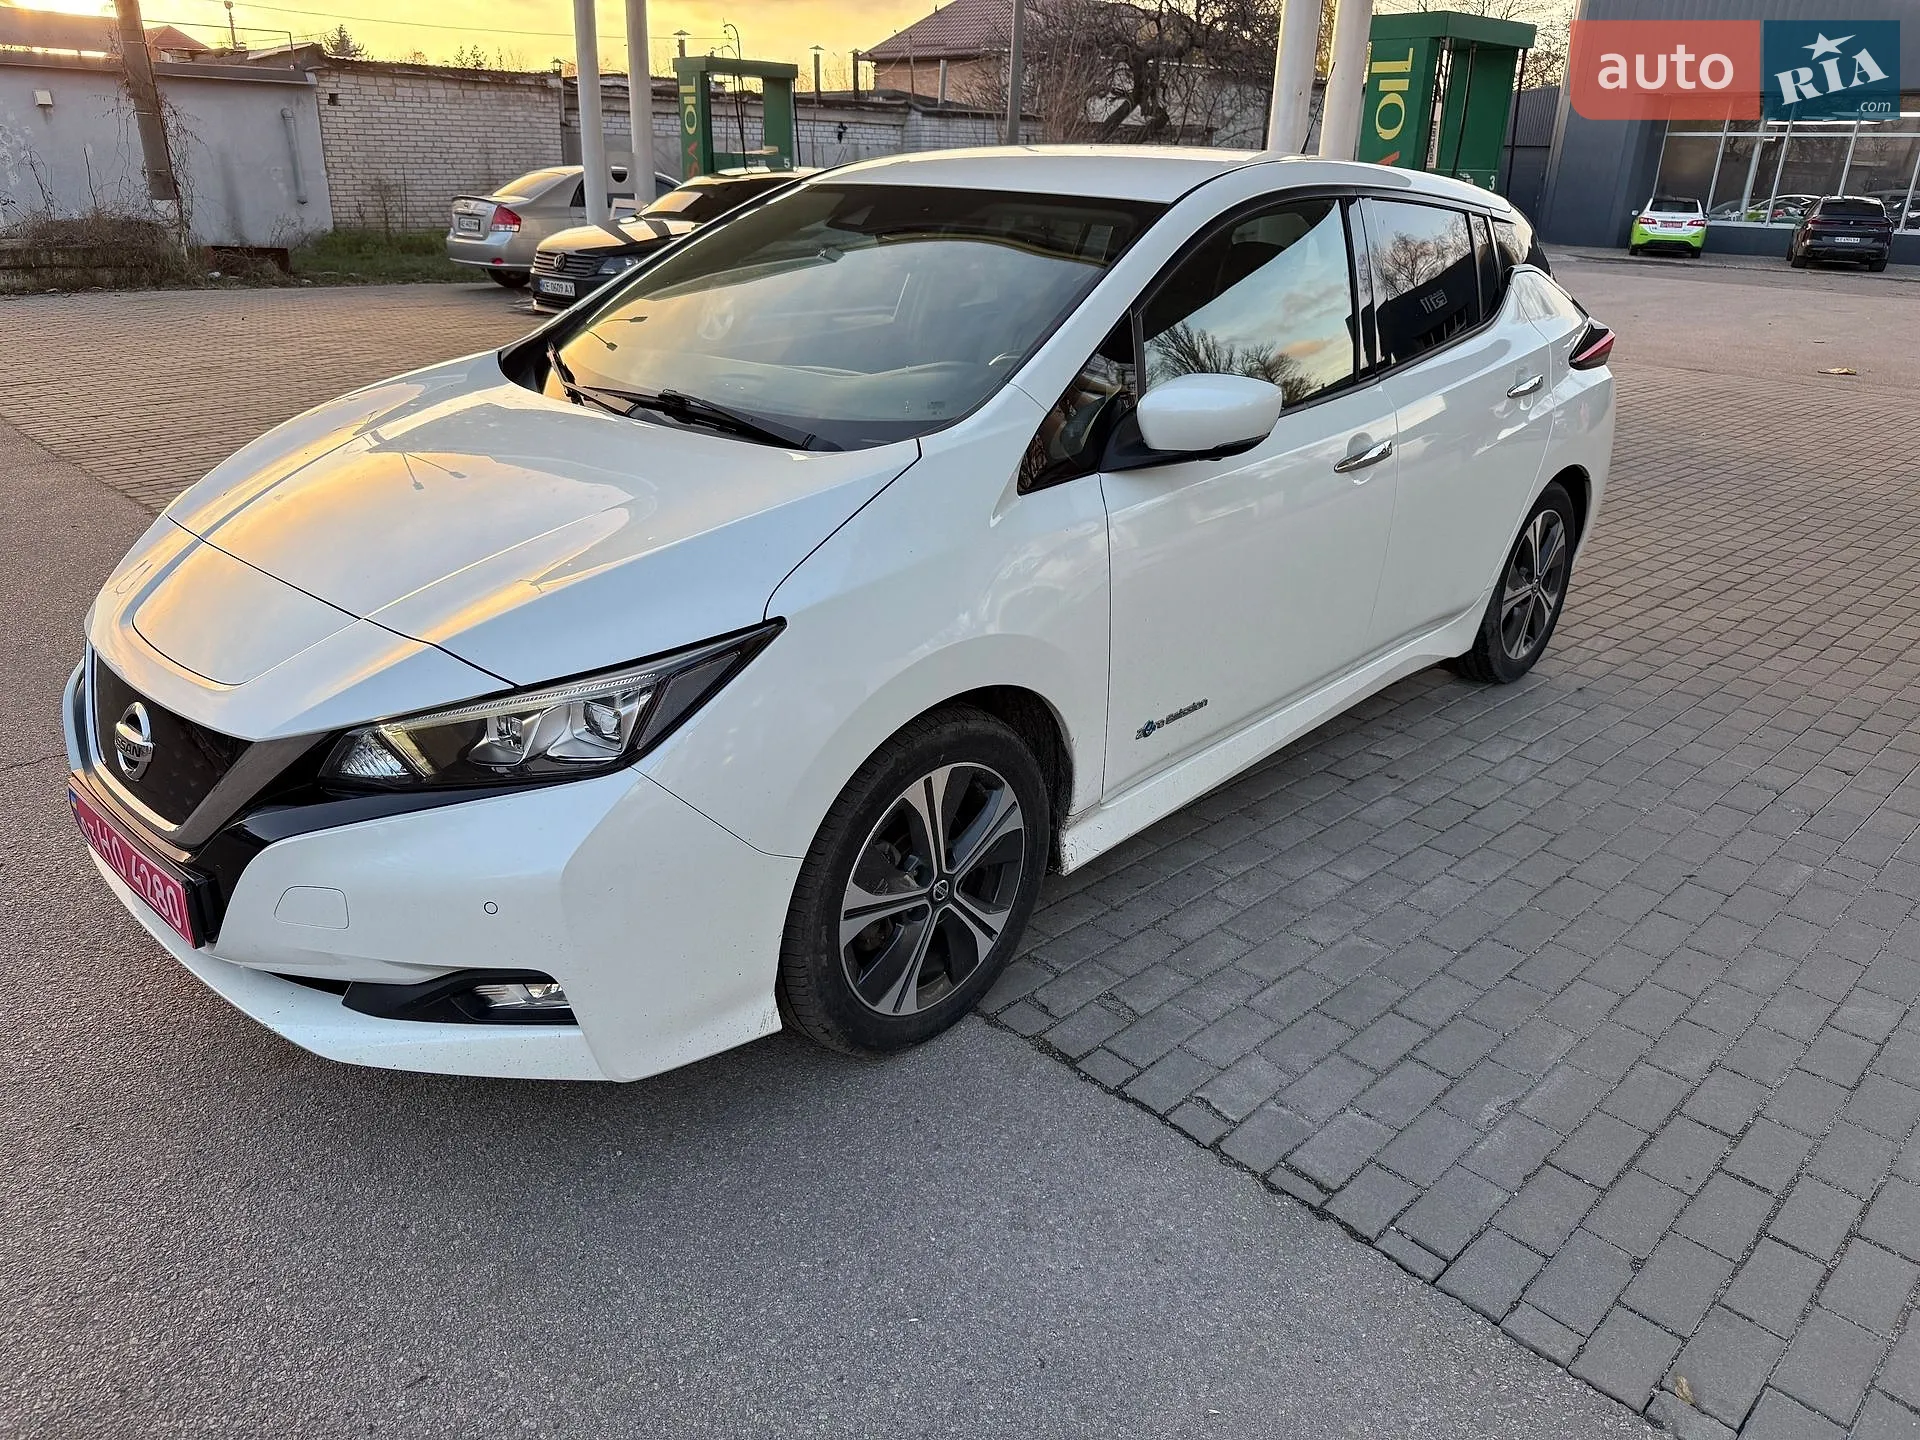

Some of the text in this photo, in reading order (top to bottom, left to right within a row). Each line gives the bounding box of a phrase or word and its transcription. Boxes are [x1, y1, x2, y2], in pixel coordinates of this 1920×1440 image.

[679, 76, 697, 135] OIL
[1371, 47, 1414, 140] OIL
[783, 157, 791, 169] 5
[1488, 175, 1496, 191] 3
[131, 854, 183, 930] 4280
